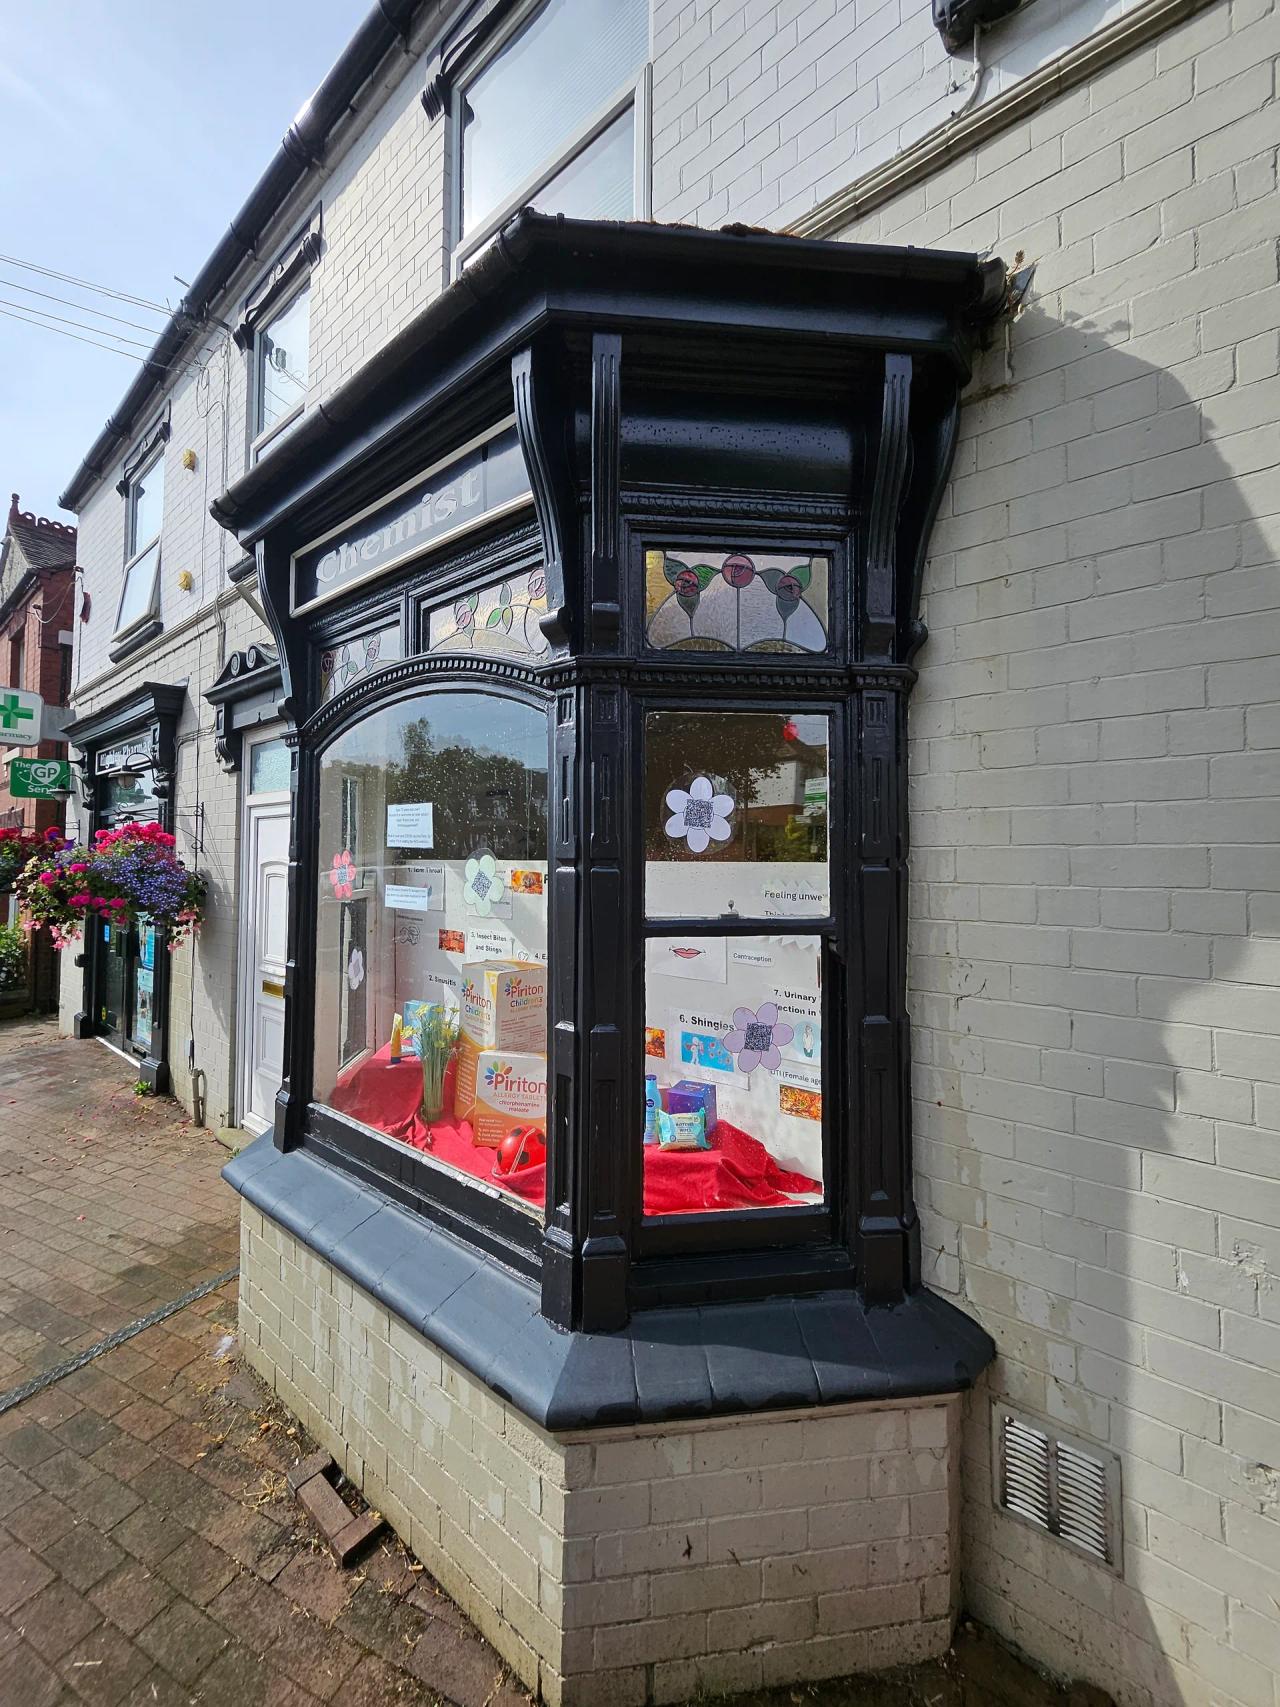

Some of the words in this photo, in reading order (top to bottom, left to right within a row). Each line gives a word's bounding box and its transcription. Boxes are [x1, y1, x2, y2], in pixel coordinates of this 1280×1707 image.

[316, 469, 480, 583] Chemist
[15, 761, 31, 769] The
[34, 766, 57, 779] GP
[764, 890, 797, 901] Feeling
[476, 932, 492, 940] Insect
[485, 945, 502, 954] Stings
[733, 953, 772, 963] Contraception
[434, 977, 457, 987] Sinusitis
[511, 985, 544, 998] Piriton
[773, 989, 782, 997] 7.
[784, 991, 817, 1004] Urinary
[465, 988, 492, 1010] Piriton
[679, 1014, 688, 1024] 6.
[691, 1016, 735, 1032] Shingles
[782, 1071, 810, 1083] (Female
[494, 1073, 547, 1094] Piriton
